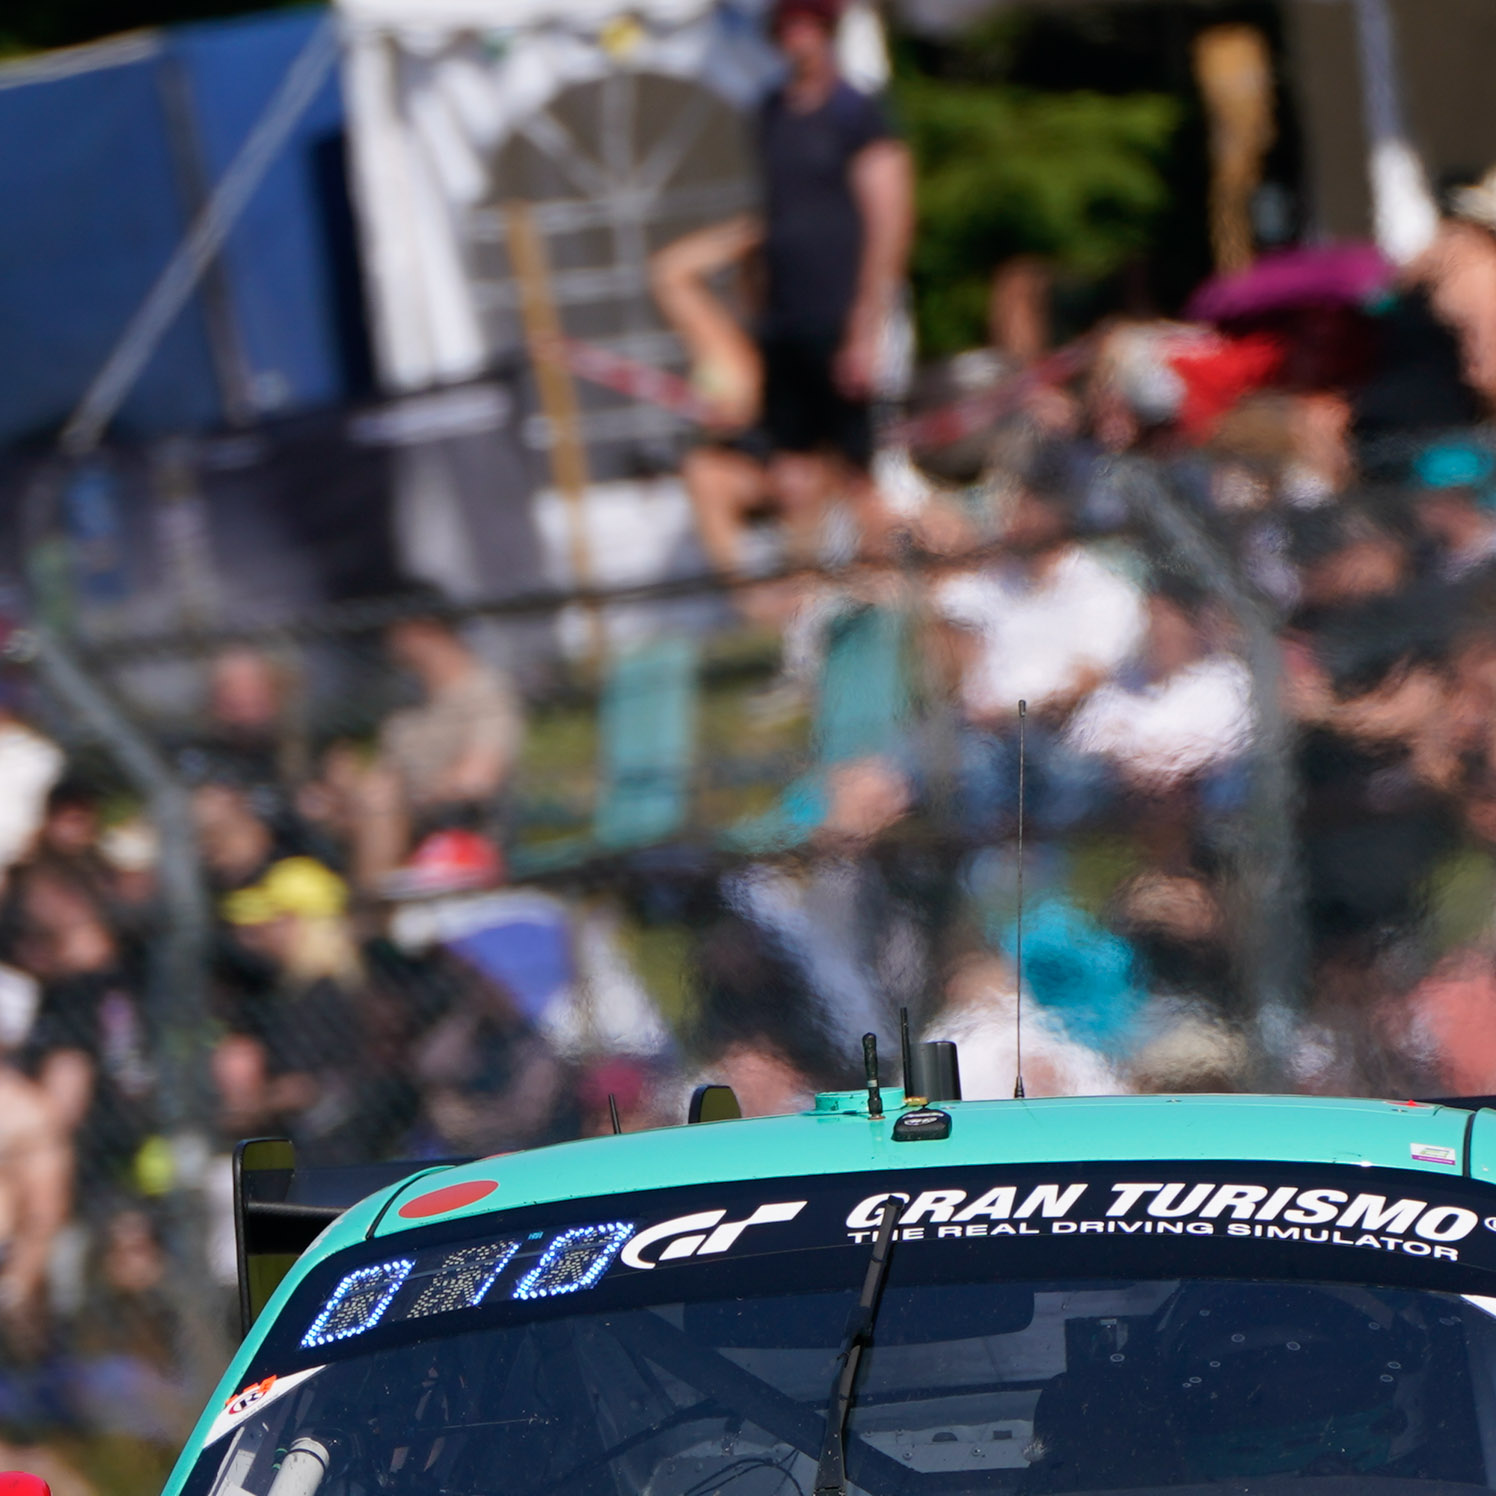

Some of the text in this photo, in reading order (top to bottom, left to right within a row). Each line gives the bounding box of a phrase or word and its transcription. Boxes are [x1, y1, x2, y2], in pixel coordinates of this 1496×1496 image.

[845, 1183, 1089, 1229] GRAN
[1105, 1182, 1479, 1242] TURISMO
[846, 1220, 1460, 1262] THE REAL DRIVING SIMULATOR
